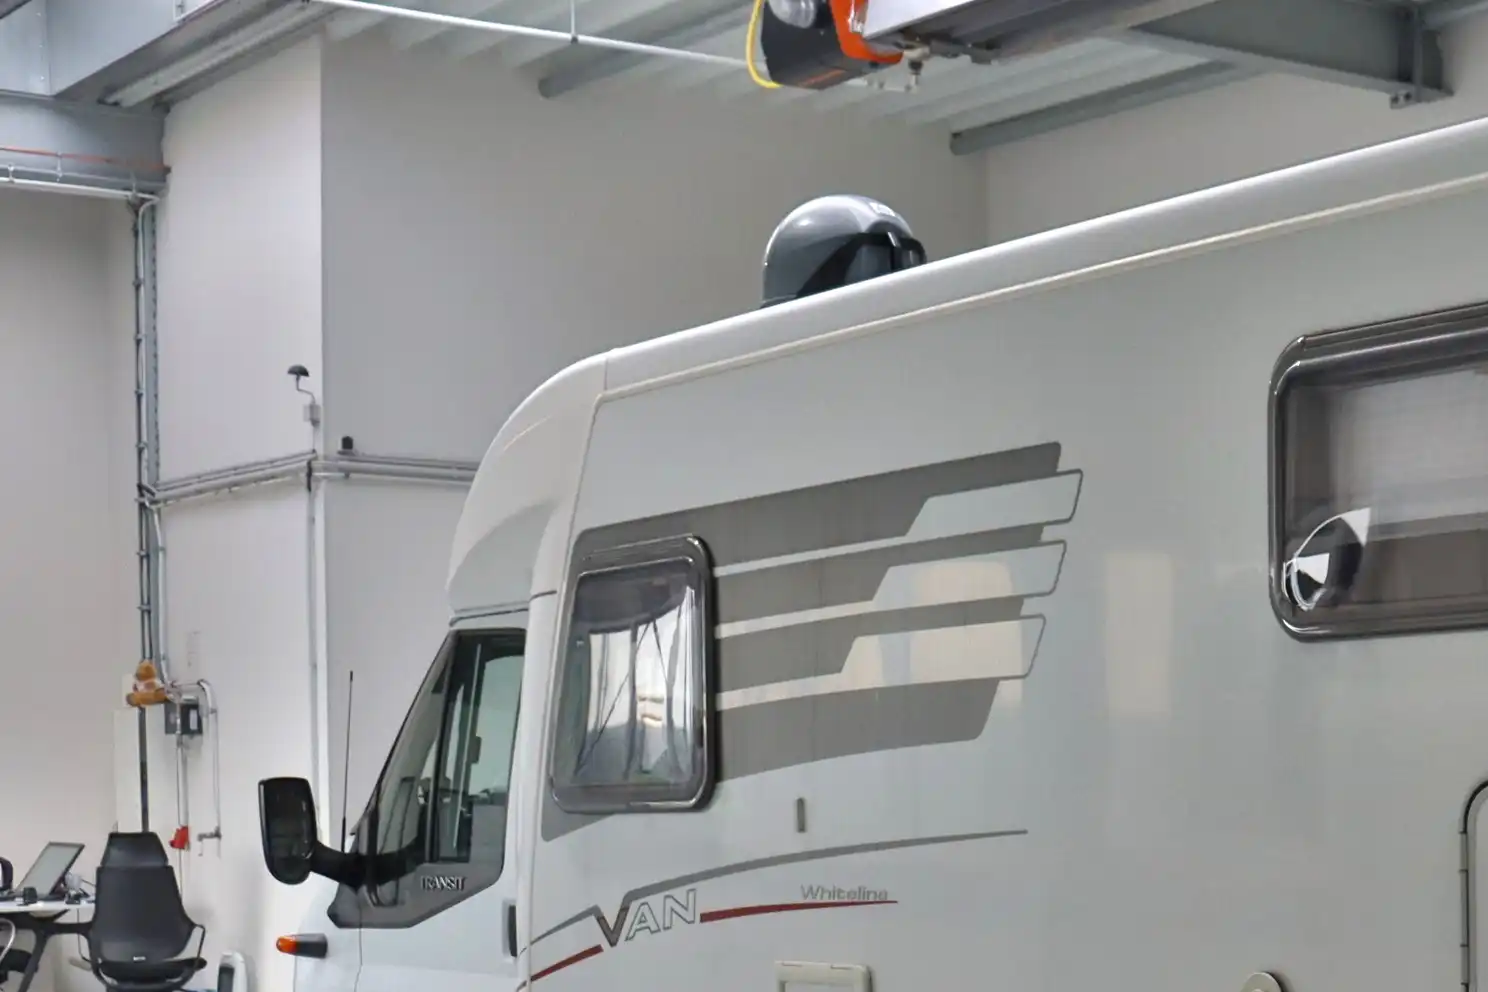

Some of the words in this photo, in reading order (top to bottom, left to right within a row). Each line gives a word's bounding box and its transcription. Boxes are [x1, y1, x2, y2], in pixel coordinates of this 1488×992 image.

[421, 875, 467, 891] TRANSIT
[800, 883, 889, 901] Whiteline
[594, 888, 698, 948] VAN
